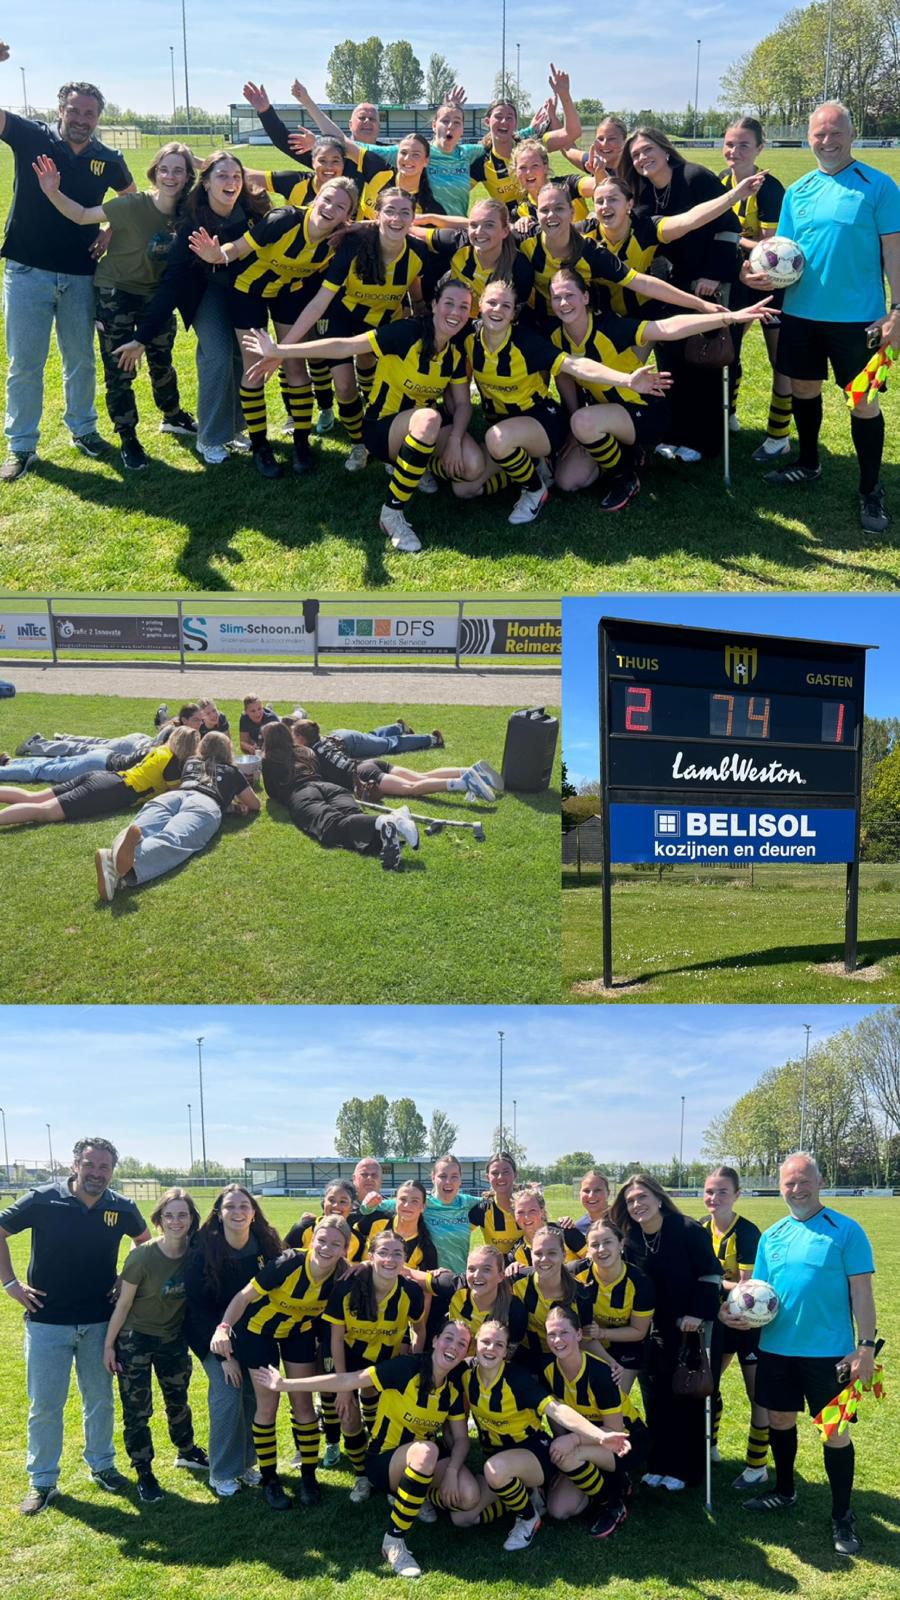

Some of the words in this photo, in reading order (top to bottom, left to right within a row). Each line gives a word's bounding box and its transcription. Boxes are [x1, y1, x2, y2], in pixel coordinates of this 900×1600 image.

[17, 623, 47, 636] INTEC
[219, 623, 305, 635] Slim-Schoon.nl
[396, 621, 434, 636] DFS
[616, 655, 659, 671] THUIS
[806, 673, 853, 687] GASTEN
[625, 687, 652, 731] 2
[713, 694, 770, 738] 74
[835, 703, 845, 742] 1
[686, 813, 816, 837] BELISOL
[654, 841, 729, 860] kozijnen
[733, 844, 754, 857] en
[759, 841, 816, 857] deuren
